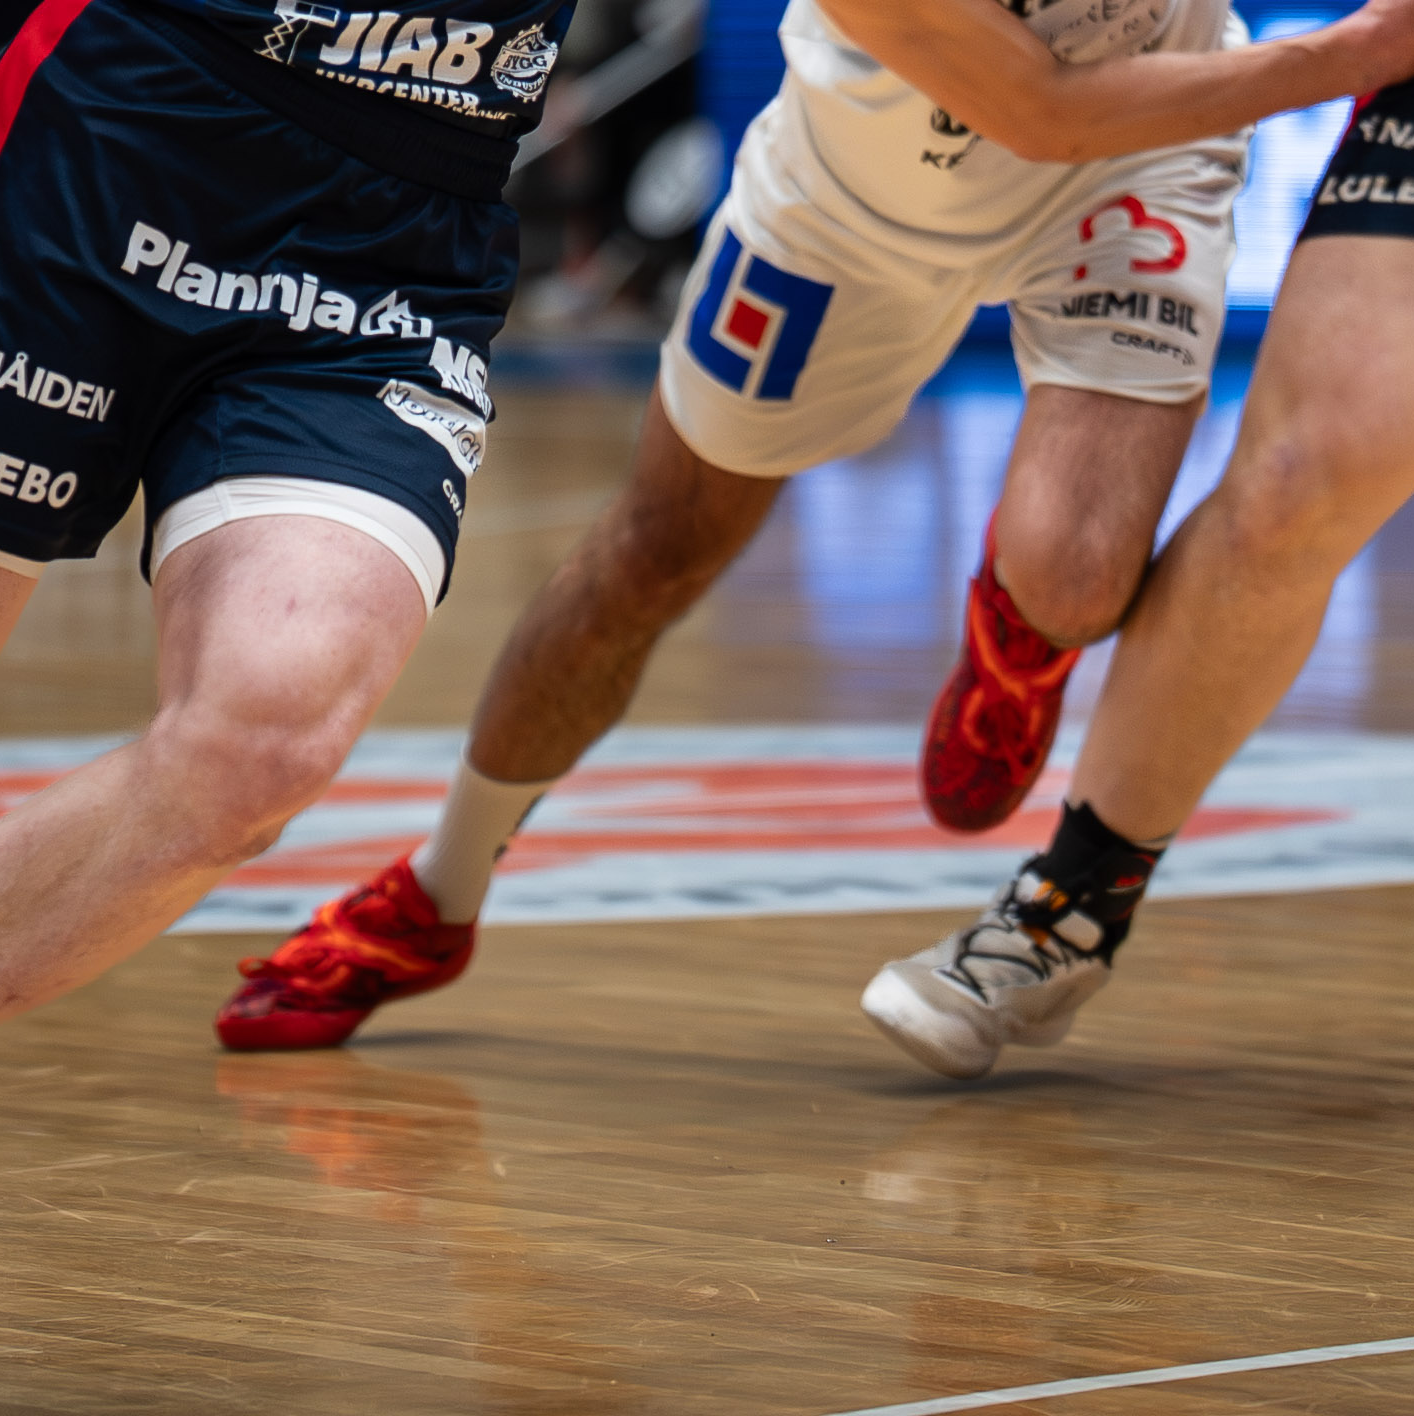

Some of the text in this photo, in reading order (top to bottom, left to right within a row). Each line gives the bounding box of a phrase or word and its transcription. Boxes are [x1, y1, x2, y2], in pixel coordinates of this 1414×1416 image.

[319, 11, 494, 85] JIAB
[503, 54, 547, 70] BYGG
[120, 220, 358, 334] Plannja
[1157, 296, 1200, 337] BIL
